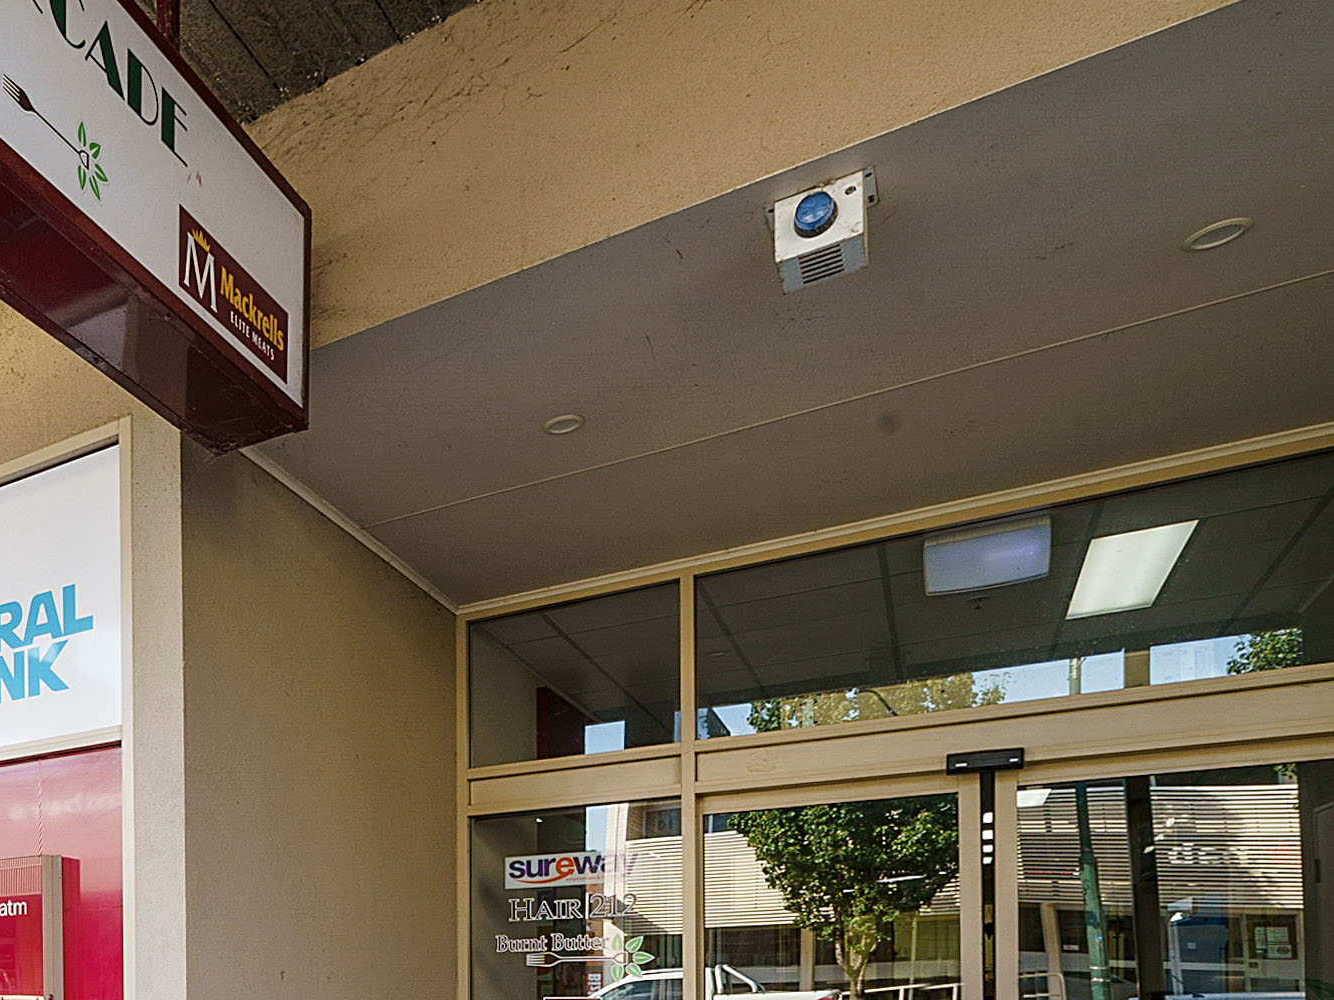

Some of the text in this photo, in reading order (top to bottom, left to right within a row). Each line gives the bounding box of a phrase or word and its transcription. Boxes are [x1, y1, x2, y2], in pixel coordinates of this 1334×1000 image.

[32, 0, 188, 168] CADE
[219, 265, 284, 352] Mackrells
[230, 311, 275, 361] ELITE MEATS
[508, 893, 639, 922] HAIR 212
[495, 932, 610, 953] Burnt Butter
